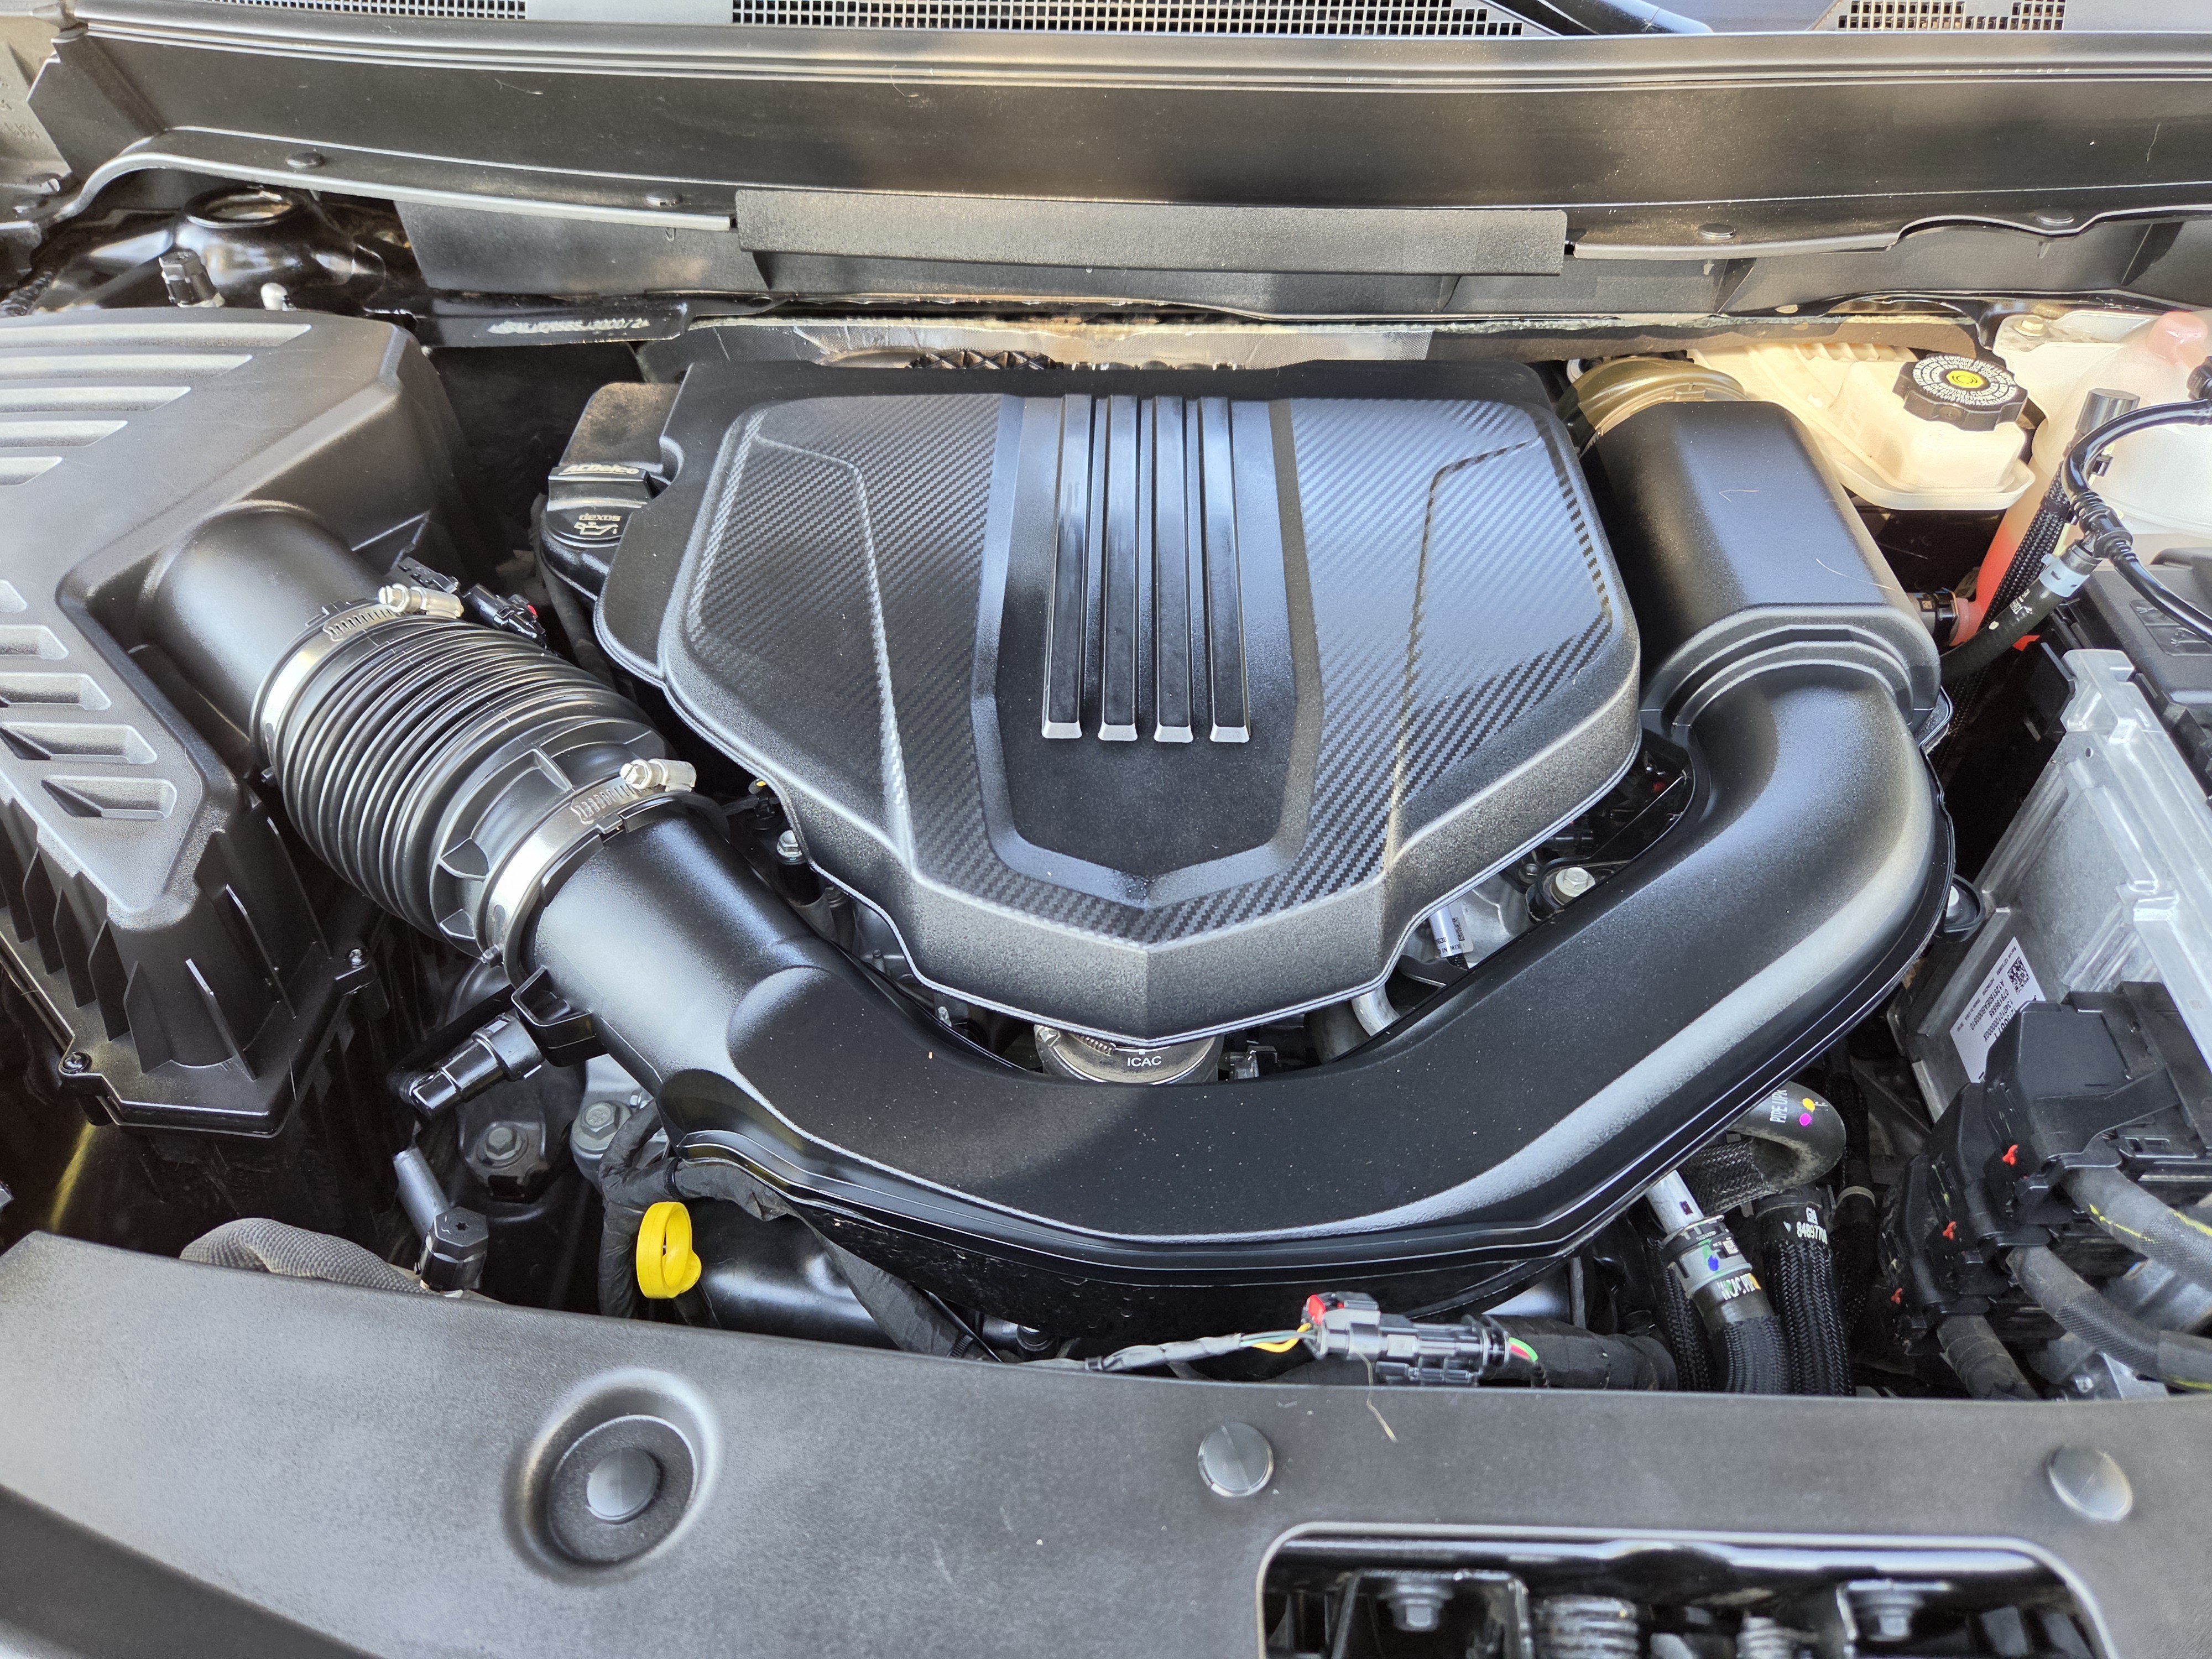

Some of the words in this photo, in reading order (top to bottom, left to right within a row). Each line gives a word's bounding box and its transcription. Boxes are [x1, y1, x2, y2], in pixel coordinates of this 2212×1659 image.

[559, 463, 640, 475] ACDelco
[578, 513, 622, 521] dexos
[1127, 1055, 1162, 1068] ICAC
[1770, 1105, 1787, 1123] PIPE
